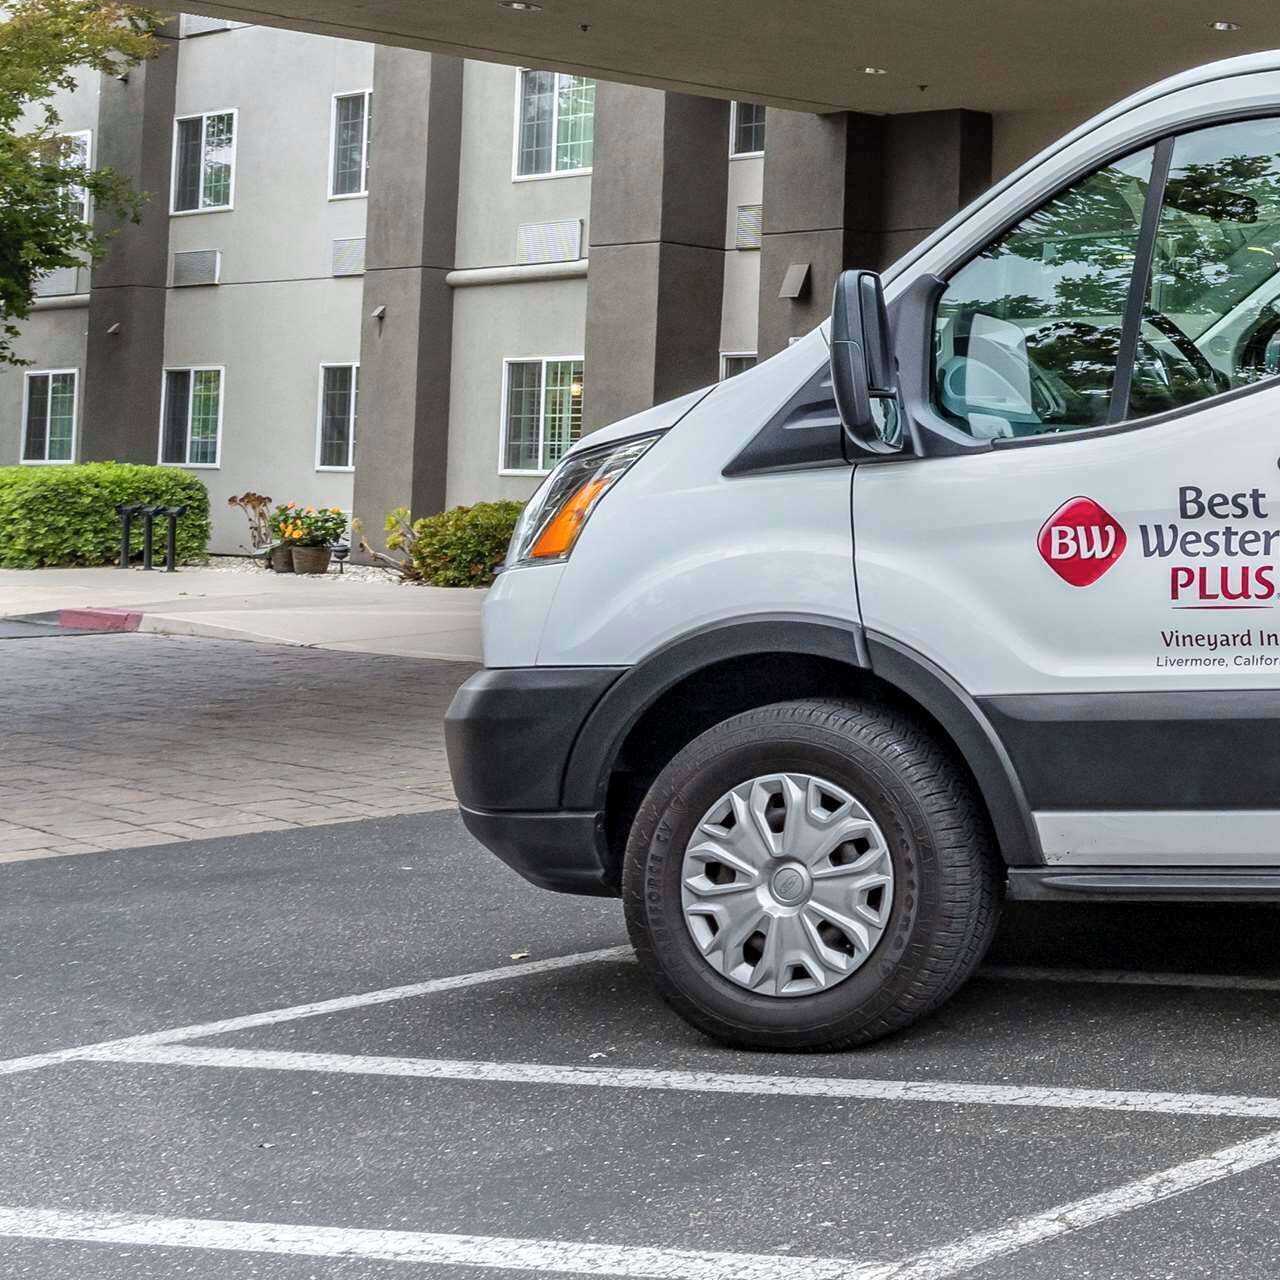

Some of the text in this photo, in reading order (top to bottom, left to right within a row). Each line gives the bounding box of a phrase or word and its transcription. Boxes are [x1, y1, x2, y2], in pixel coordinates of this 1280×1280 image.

[1179, 486, 1269, 520] Best
[1050, 524, 1116, 560] BW
[1171, 565, 1276, 601] PLUS
[1161, 629, 1253, 652] Vineyard
[1156, 654, 1229, 668] Livermore,
